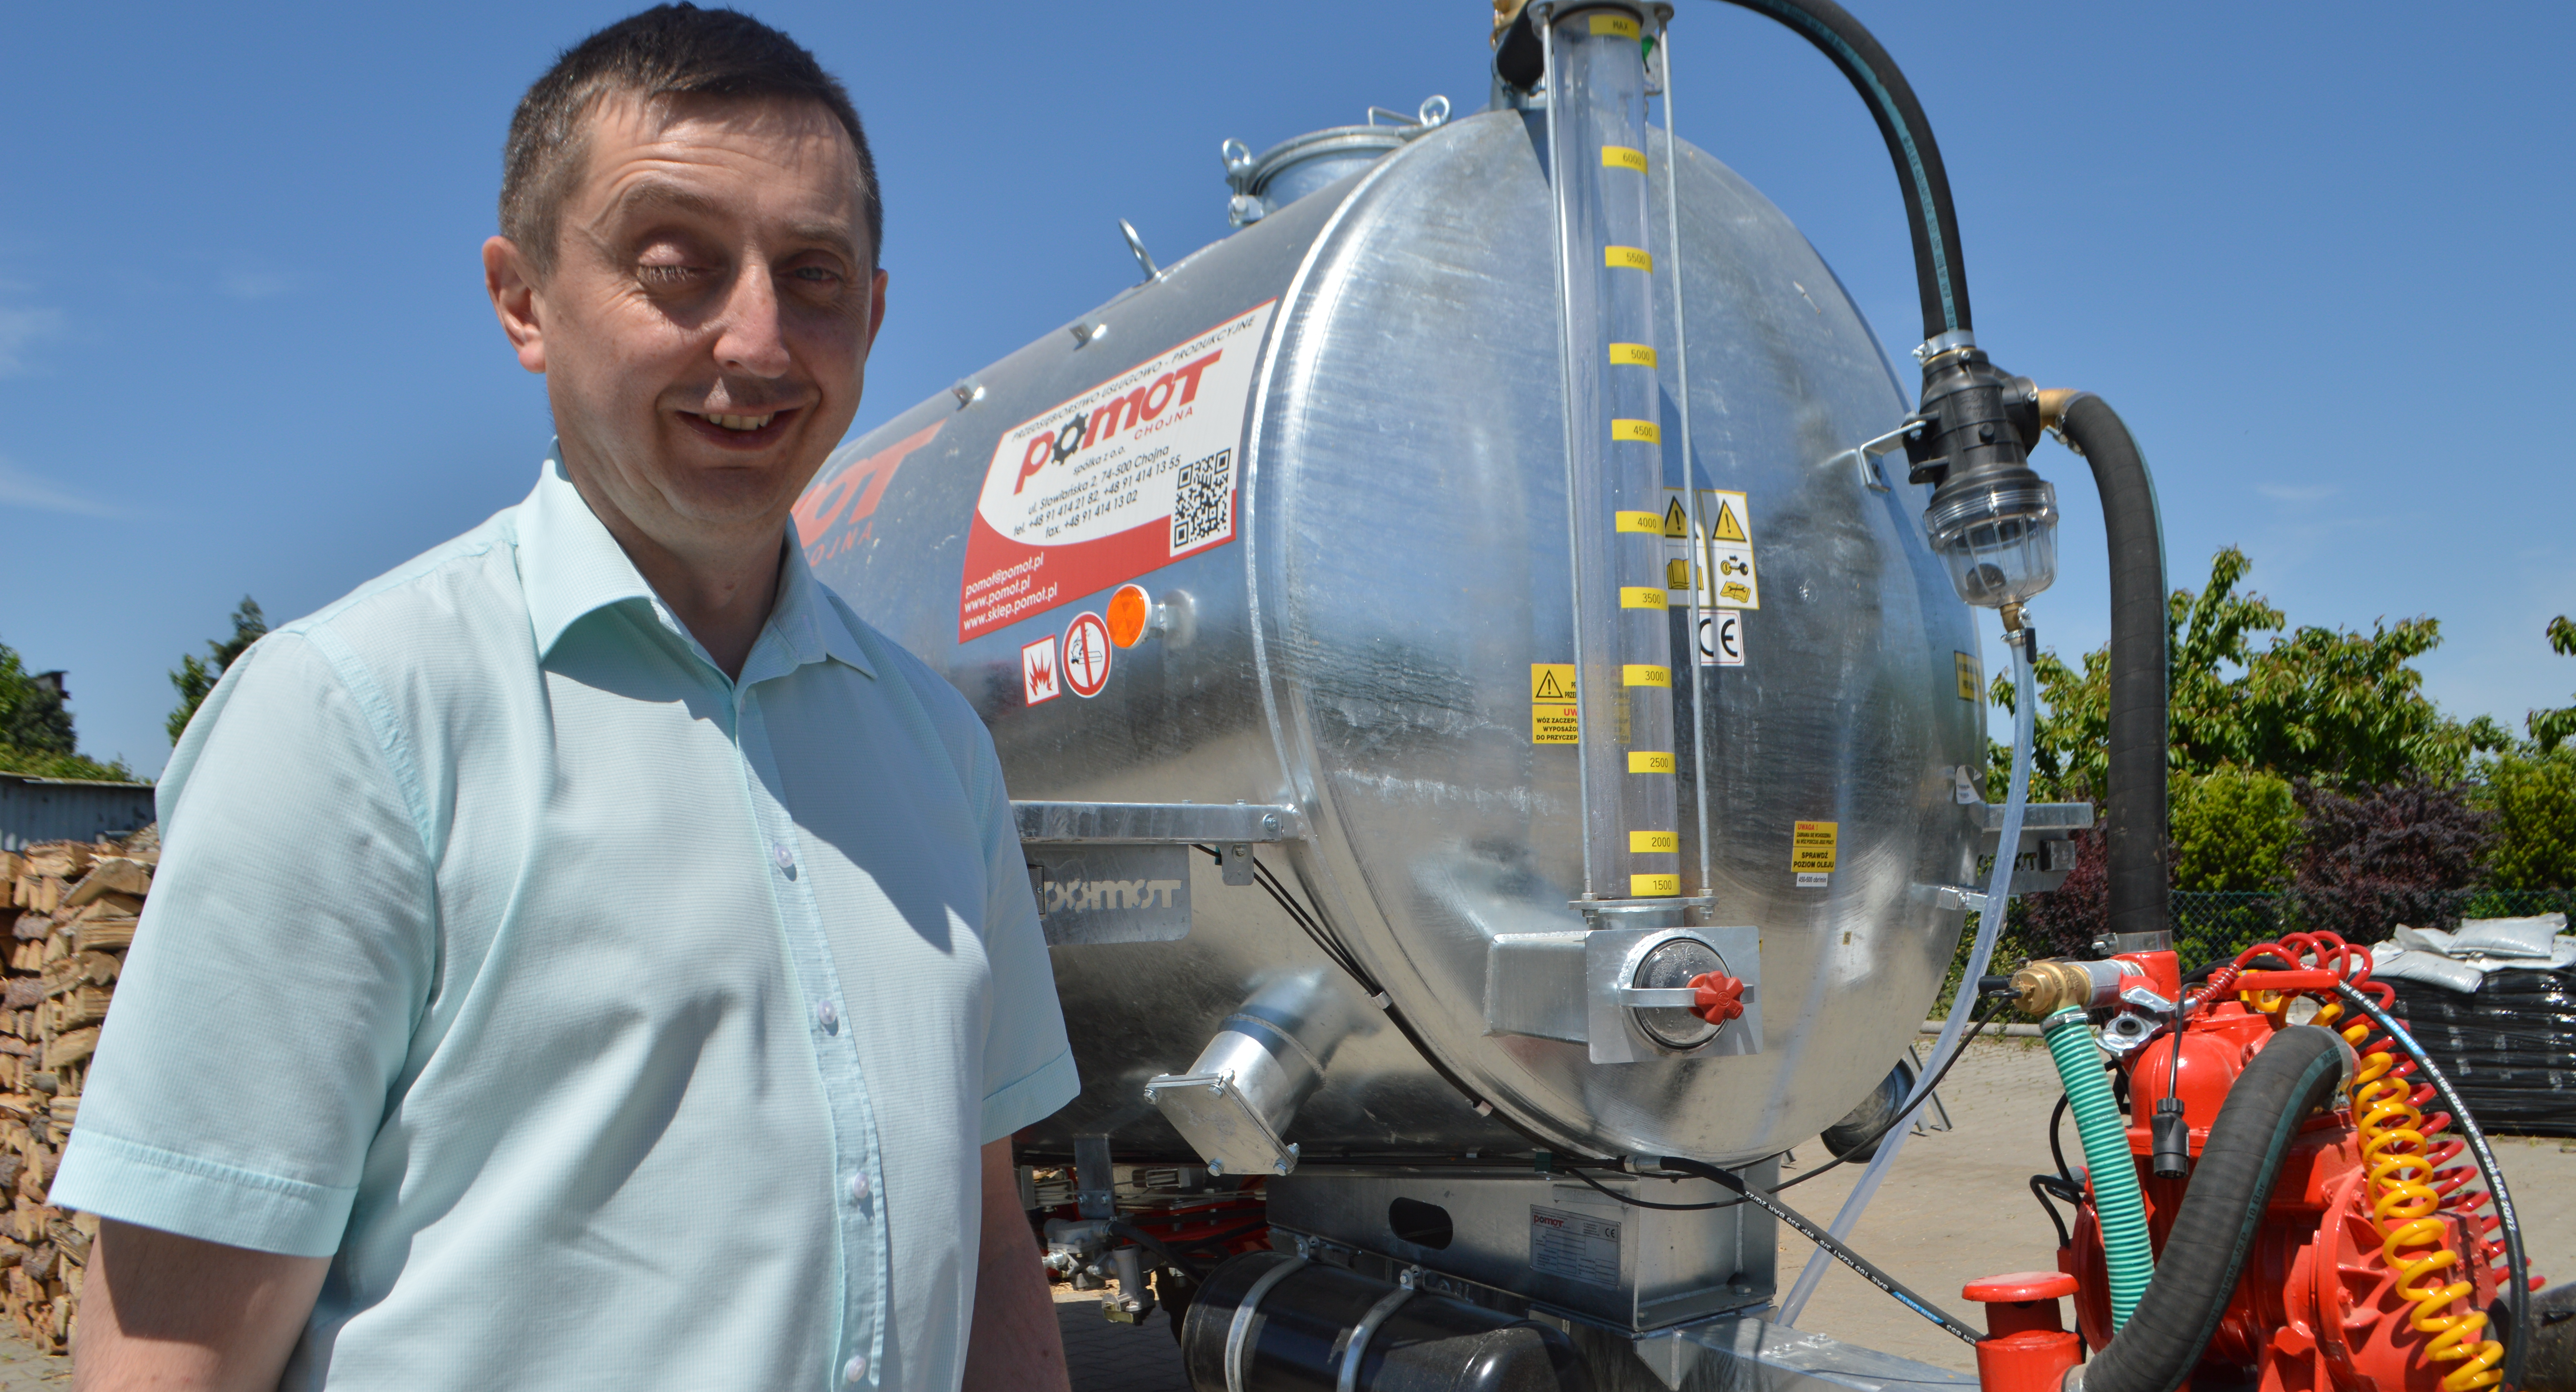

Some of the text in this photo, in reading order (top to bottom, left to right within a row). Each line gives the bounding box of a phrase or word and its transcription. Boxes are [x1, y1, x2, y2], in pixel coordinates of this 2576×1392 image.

[1613, 20, 1628, 30] MAX
[1623, 152, 1641, 166] 6000
[1627, 252, 1646, 264] 5500
[1102, 361, 1162, 398] USŁUGOWO
[1172, 315, 1255, 364] PRODUKCYJNE
[1631, 349, 1650, 361] 5000
[1134, 406, 1193, 440] CHOJNA
[1633, 425, 1653, 438] 4500
[1110, 446, 1125, 459] o.o.
[1028, 502, 1037, 515] ul.
[1101, 459, 1132, 483] 74-500
[1134, 445, 1169, 468] Chojna
[1014, 522, 1025, 536] tel.
[1029, 514, 1044, 528] +48
[1046, 509, 1055, 522] 91
[1058, 501, 1073, 516] 414
[1074, 495, 1085, 510] 21
[1104, 480, 1120, 495] +48
[1123, 475, 1132, 489] 91
[1135, 466, 1152, 483] 414
[1156, 460, 1166, 475] 13
[1169, 454, 1181, 469] 55
[1046, 489, 1138, 539] fax. +48 91 414 13 02
[1637, 517, 1657, 529] 4000
[805, 520, 873, 567] OJNA
[965, 551, 1044, 599] pomot@pomot.pl
[964, 574, 1030, 613] www.pomot.pl
[1642, 593, 1661, 605] 3500
[963, 581, 1058, 631] www.sklep.pomot.pl
[1699, 618, 1738, 657] CE
[1645, 671, 1664, 681] 3000
[1650, 757, 1669, 768] 2500
[1651, 837, 1671, 848] 2000
[1801, 850, 1828, 859] SPRAWDŹ
[1652, 880, 1672, 891] 1500
[2351, 989, 2364, 1001] EN
[2363, 998, 2380, 1012] 853
[2383, 1017, 2399, 1031] 2SN
[2399, 1029, 2420, 1051] DN10
[2422, 1058, 2441, 1078] SAE
[2438, 1077, 2451, 1093] 100
[2448, 1092, 2469, 1116] R2AT
[2475, 1137, 2488, 1154] WP
[2483, 1156, 2497, 1174] 330
[2491, 1175, 2507, 1199] BAR
[1768, 1204, 1786, 1219] BAR
[1786, 1216, 1801, 1229] 330
[1605, 1228, 1616, 1238] CE
[1801, 1228, 1815, 1239] WP
[1833, 1249, 1854, 1267] R2AT
[2206, 1308, 2219, 1327] DN
[2219, 1264, 2238, 1301] 70MM
[2246, 1207, 2257, 1223] 10
[2252, 1183, 2265, 1204] Bar
[1854, 1265, 1869, 1277] 100
[1871, 1276, 1889, 1291] SAE
[1896, 1294, 1919, 1311] DN10
[1920, 1308, 1938, 1323] 2SN
[1946, 1324, 1962, 1337] 853
[1963, 1334, 1976, 1344] EN
